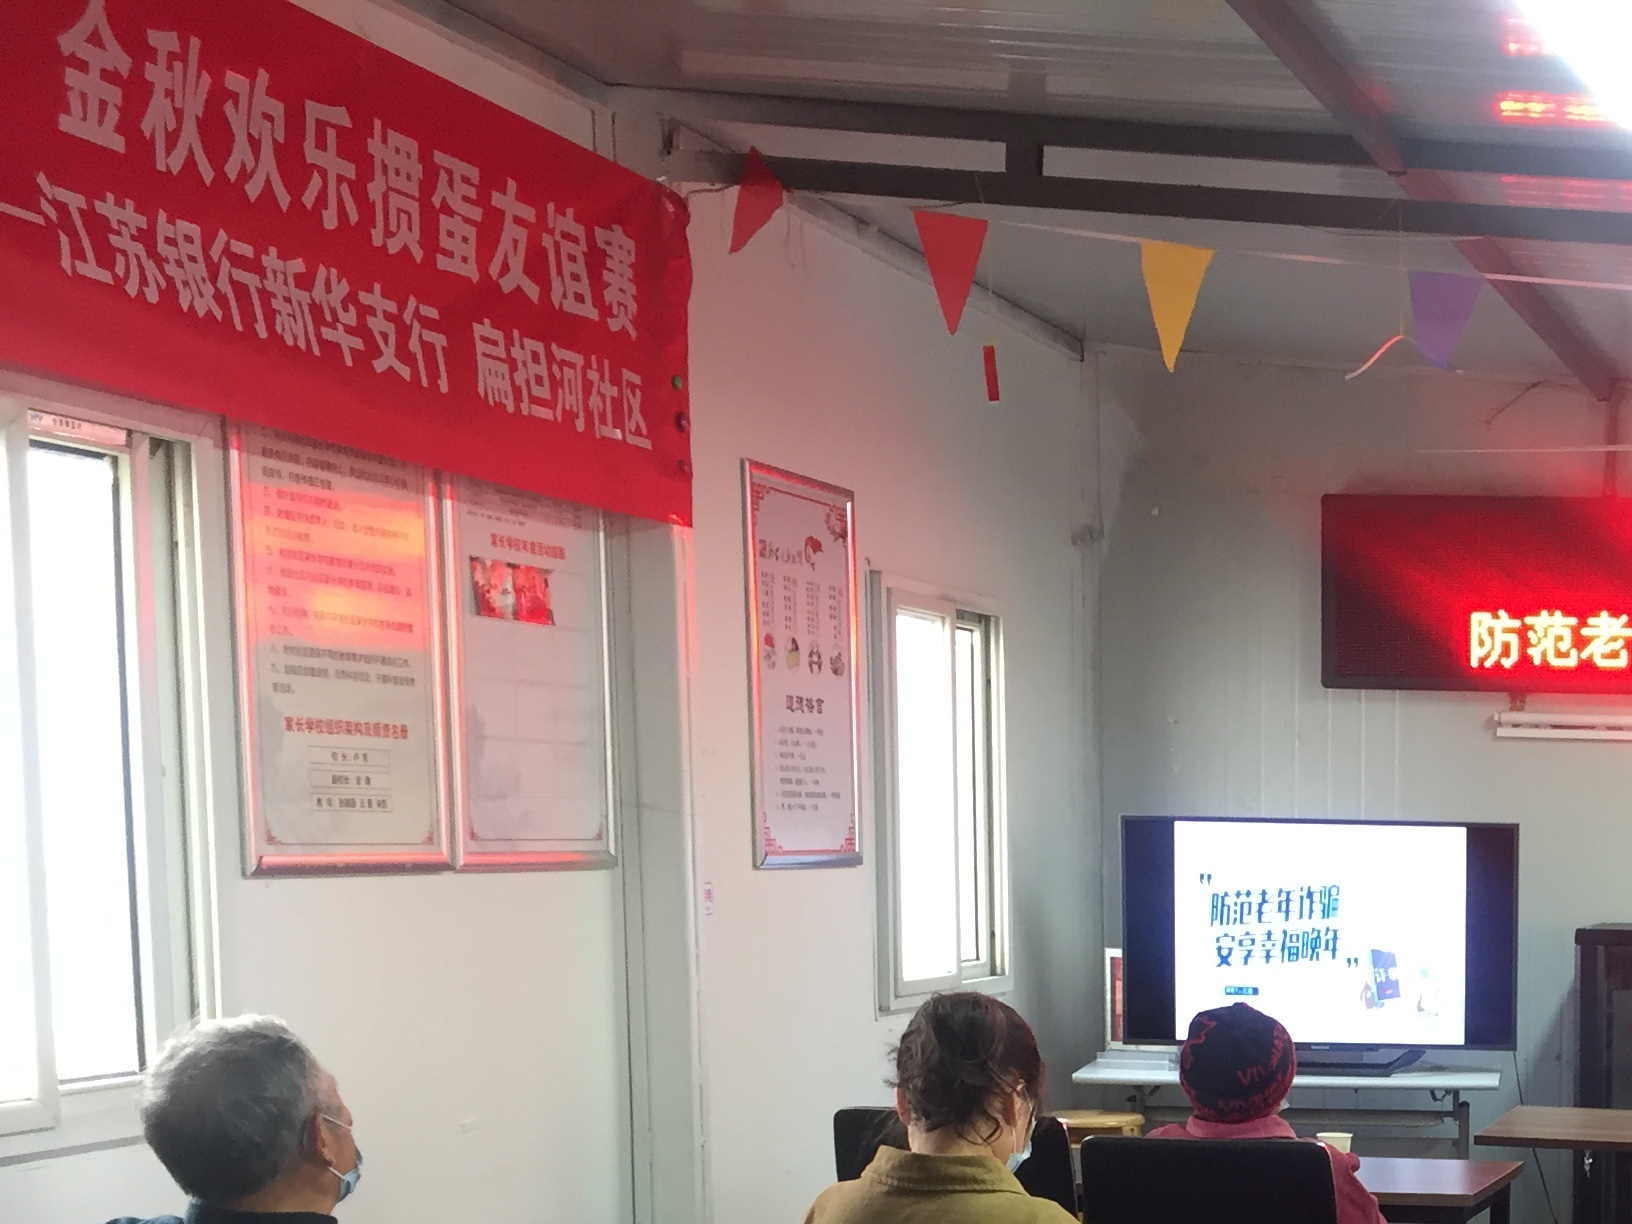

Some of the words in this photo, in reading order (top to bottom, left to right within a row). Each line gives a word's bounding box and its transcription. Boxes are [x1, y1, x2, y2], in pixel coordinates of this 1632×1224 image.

[57, 0, 639, 342] 金秋欢乐掼蛋友谊赛
[472, 317, 653, 451] 扁担河社区
[1210, 884, 1340, 928] 防范老年诈骗
[1215, 926, 1342, 968] 安享幸福晚年
